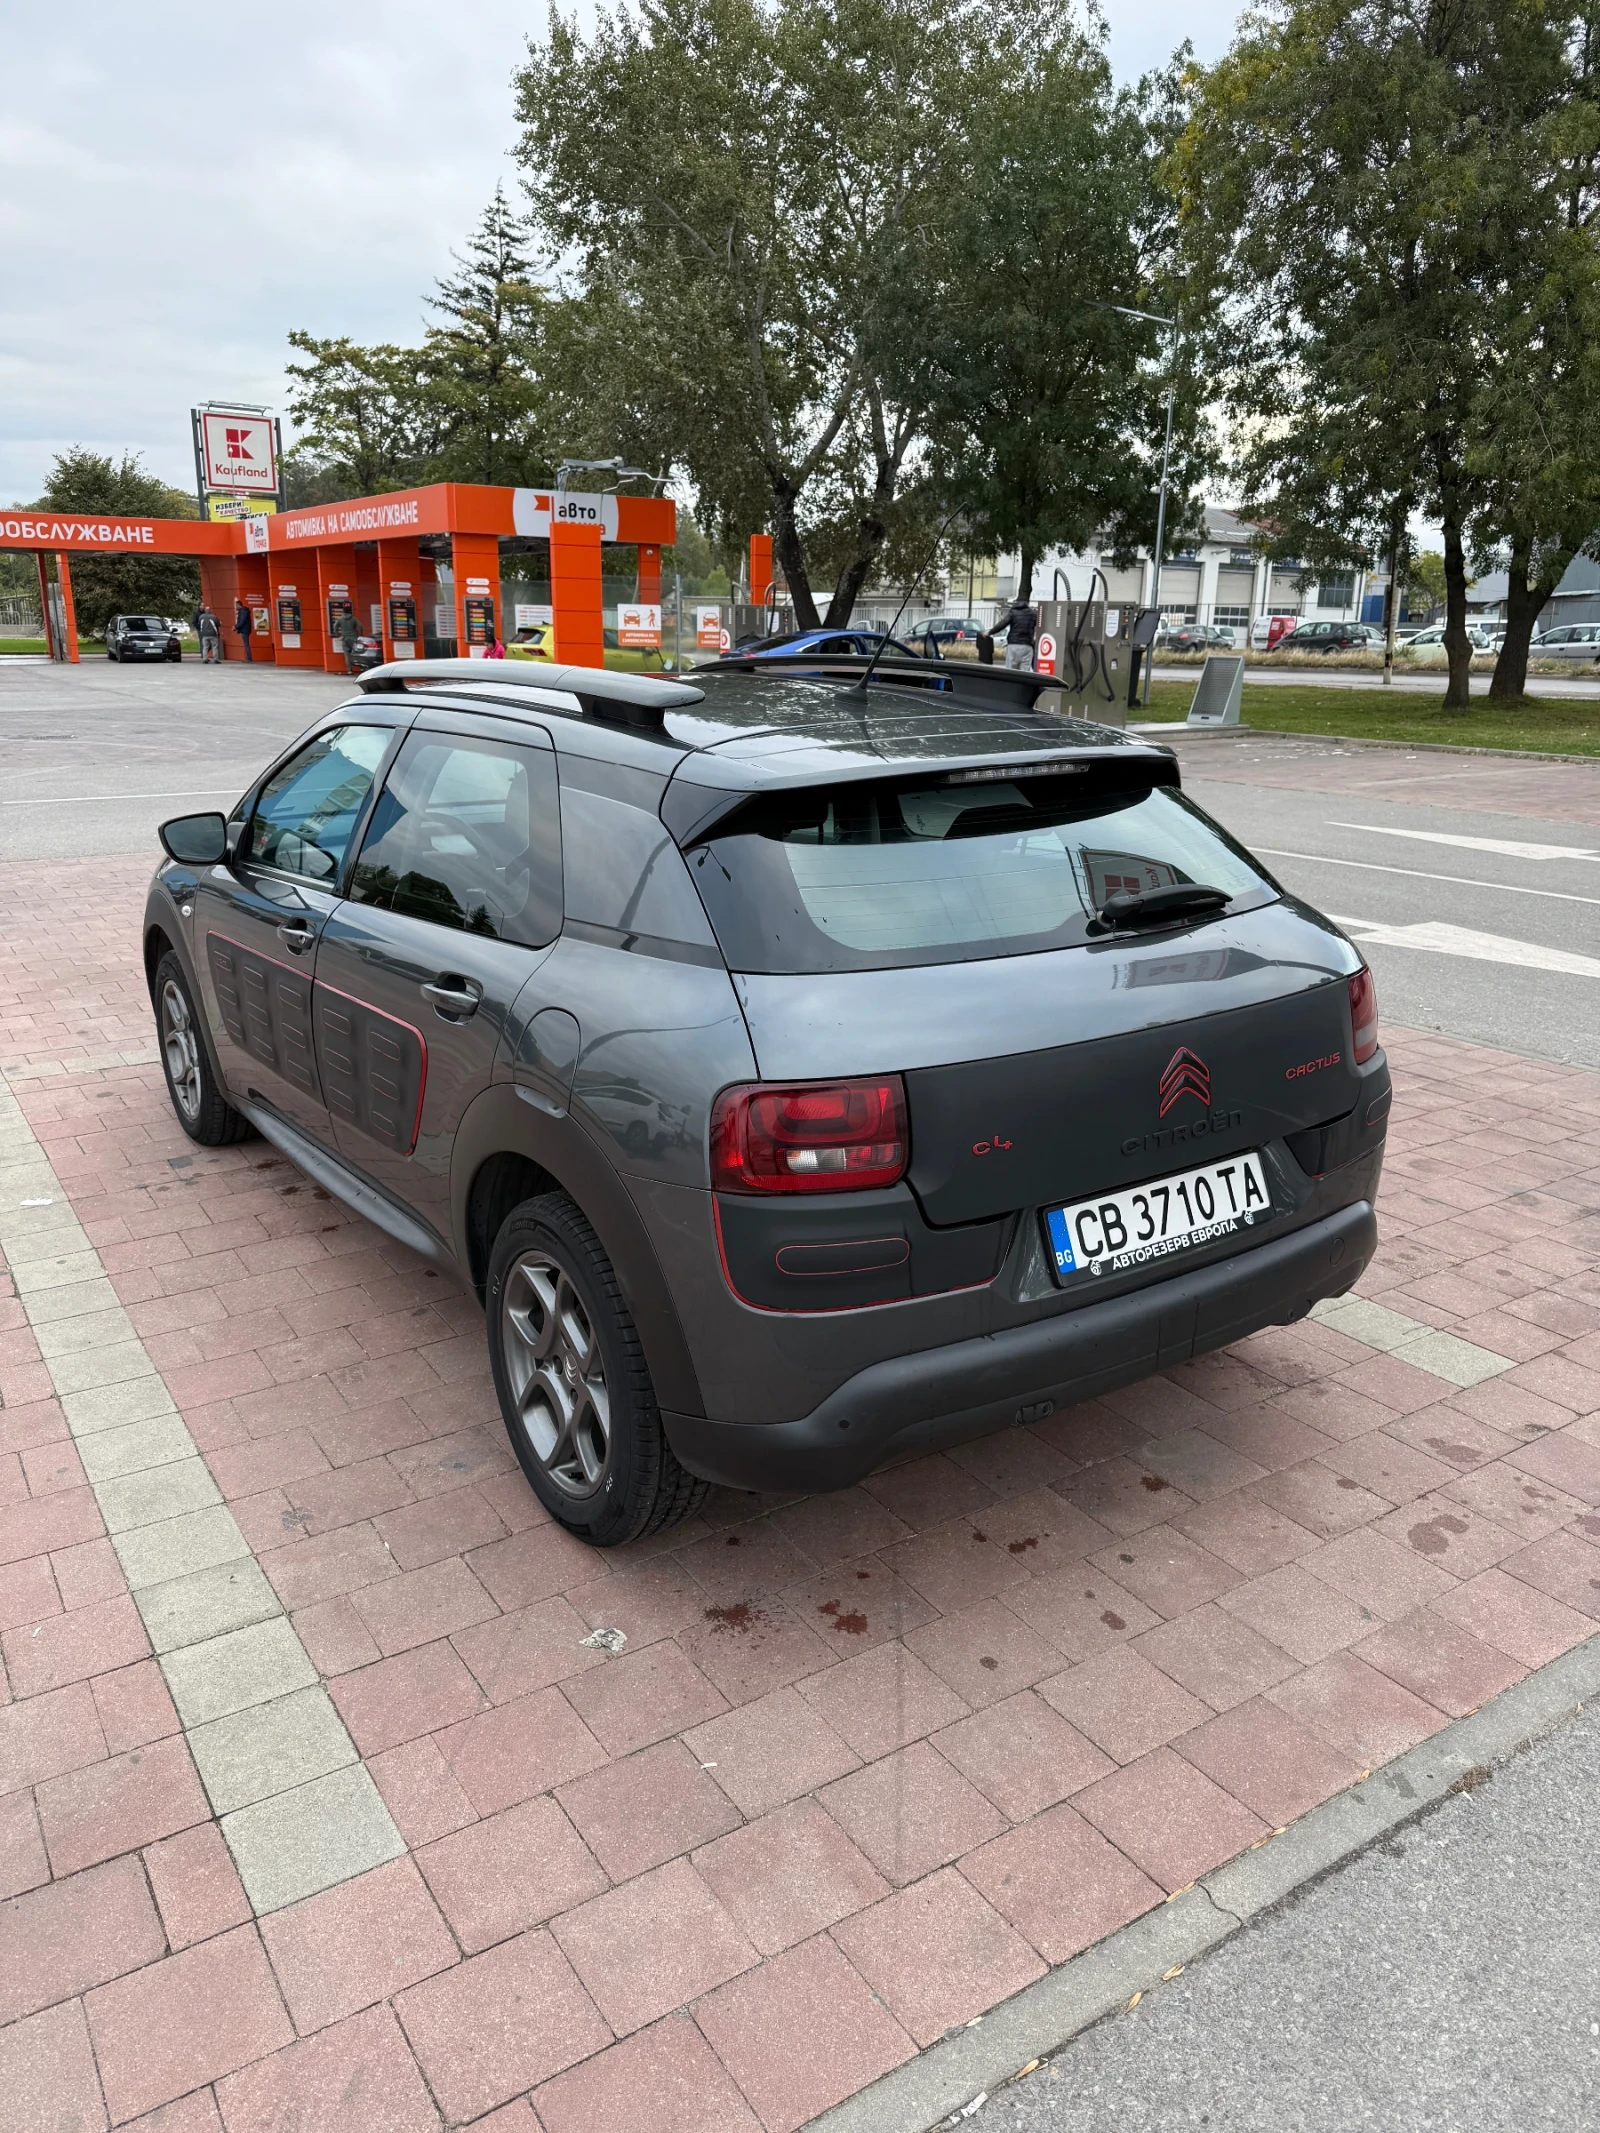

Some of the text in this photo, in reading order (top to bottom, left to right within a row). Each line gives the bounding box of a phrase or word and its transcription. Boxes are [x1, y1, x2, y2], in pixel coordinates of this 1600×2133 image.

[215, 464, 268, 478] Kaufland
[215, 502, 242, 510] ИЗБЕРИ
[558, 502, 596, 519] авто
[286, 500, 419, 539] АВТОМИВКА НА САМООБСЛУЖВАНЕ
[0, 520, 154, 544] ОБСЛУЖВАНЕ
[1284, 1051, 1341, 1081] CACTUS
[1075, 1161, 1264, 1258] CB 3710 TA
[1112, 1234, 1191, 1271] АВТОРЕЗЕРВ
[1191, 1218, 1238, 1243] ЕВРОПА
[1055, 1249, 1073, 1267] BG
